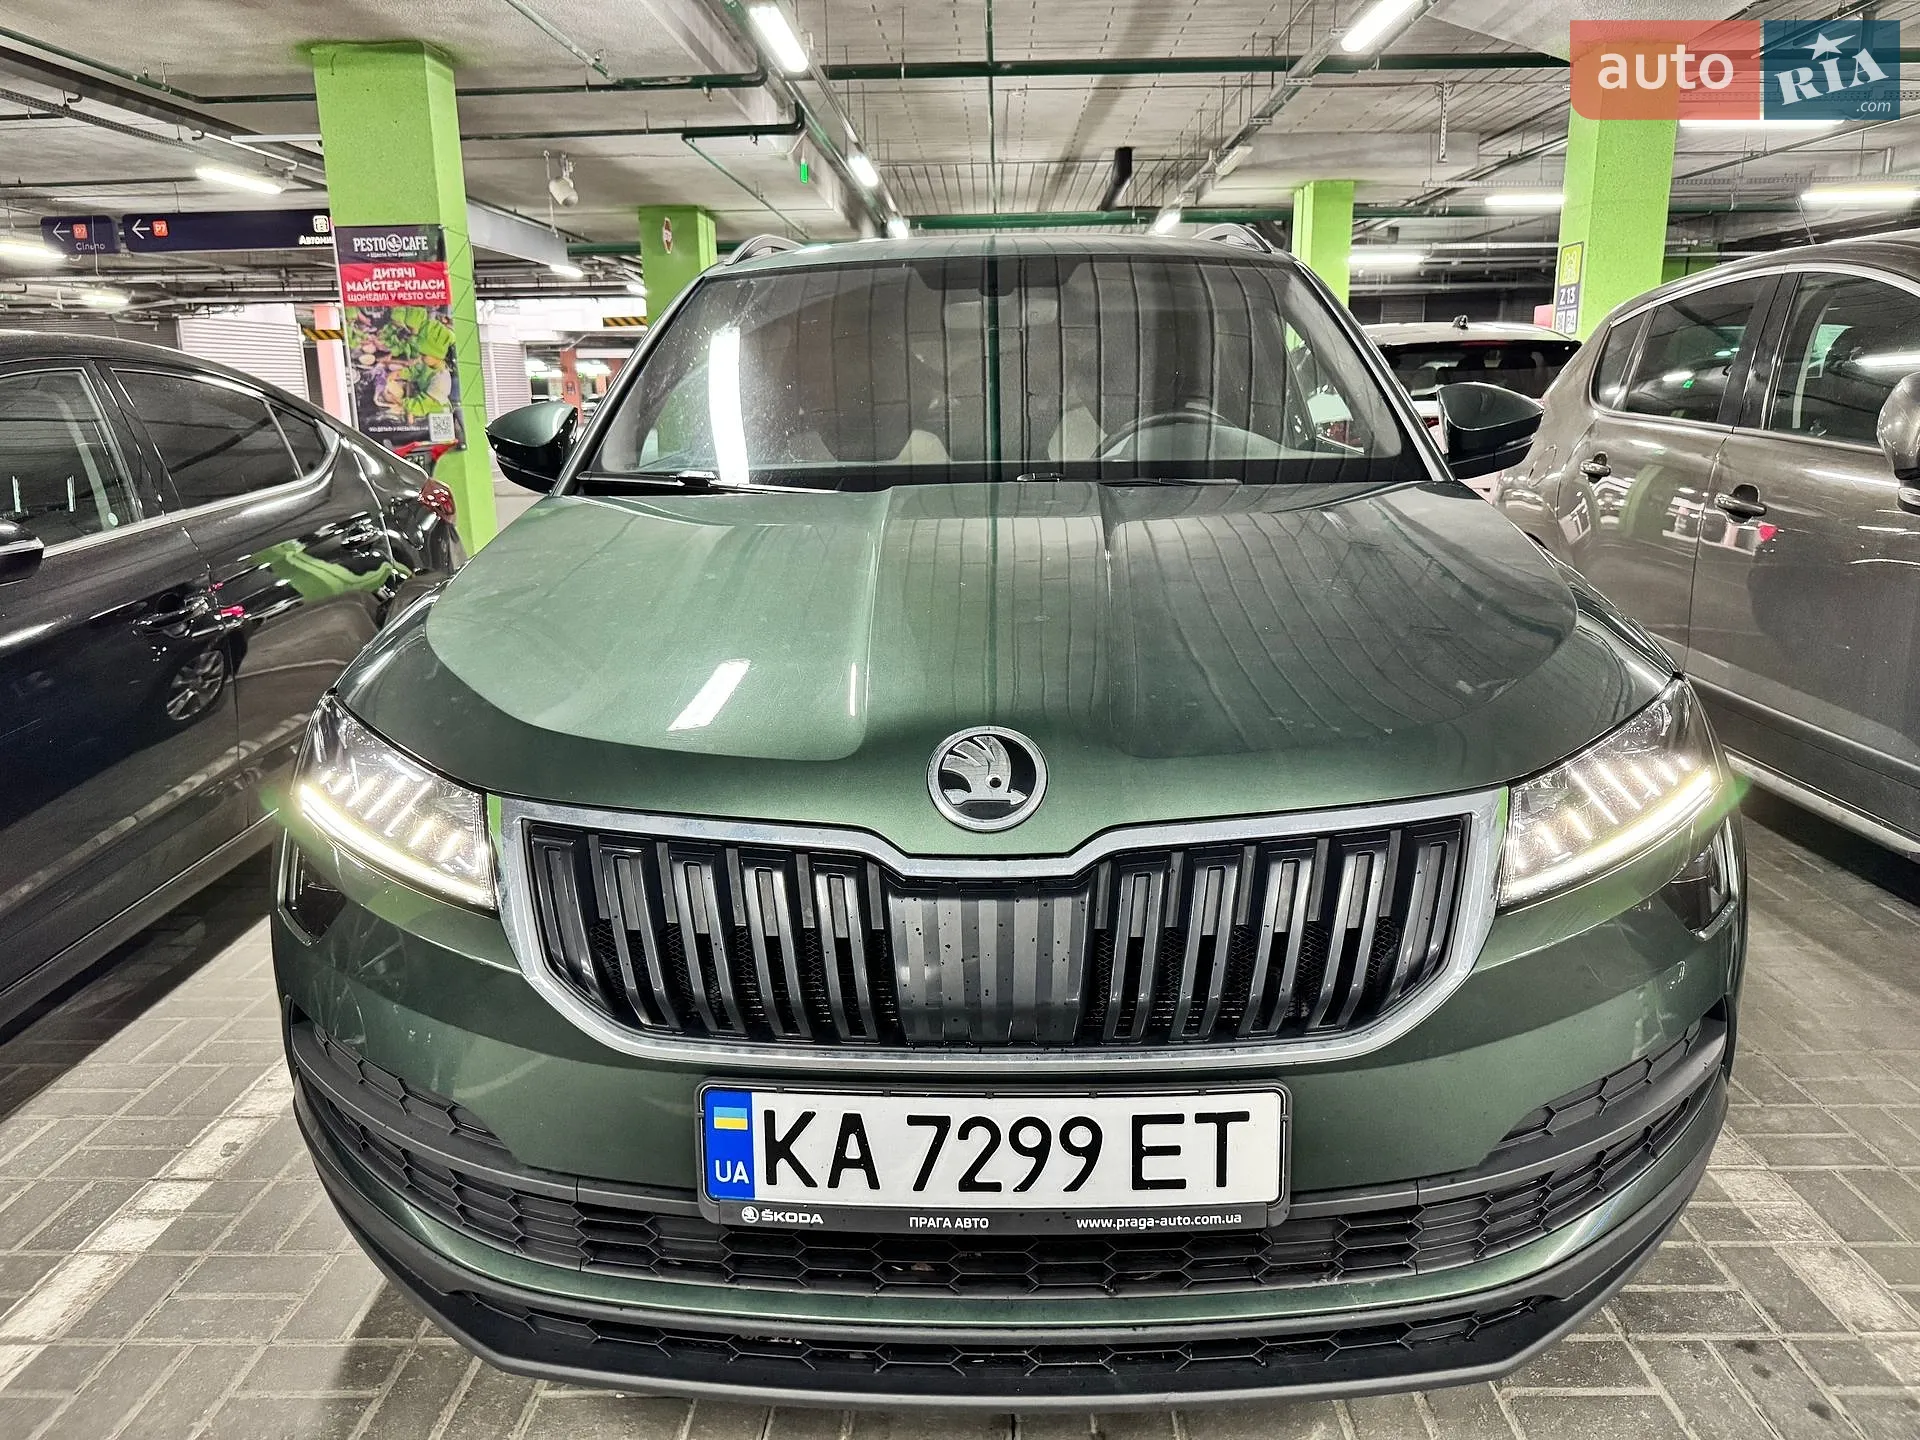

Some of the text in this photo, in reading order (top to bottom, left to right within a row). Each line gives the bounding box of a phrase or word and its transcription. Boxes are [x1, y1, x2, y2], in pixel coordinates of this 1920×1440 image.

[353, 236, 428, 252] PESTO CAFE
[373, 267, 416, 280] ДИТЯЧІ
[345, 278, 445, 292] МАЙСТЕР-КЛАСИ
[347, 293, 390, 303] ЩОНЕДІЛІ
[397, 292, 425, 300] PESTO
[425, 291, 447, 300] CAFE
[764, 1109, 1251, 1193] KA 7299 ET
[715, 1159, 750, 1184] UA
[761, 1209, 824, 1224] ŠKODA
[909, 1217, 989, 1229] ПРАГА АВТО
[1076, 1214, 1242, 1230] www.praga-auto.com.ua
